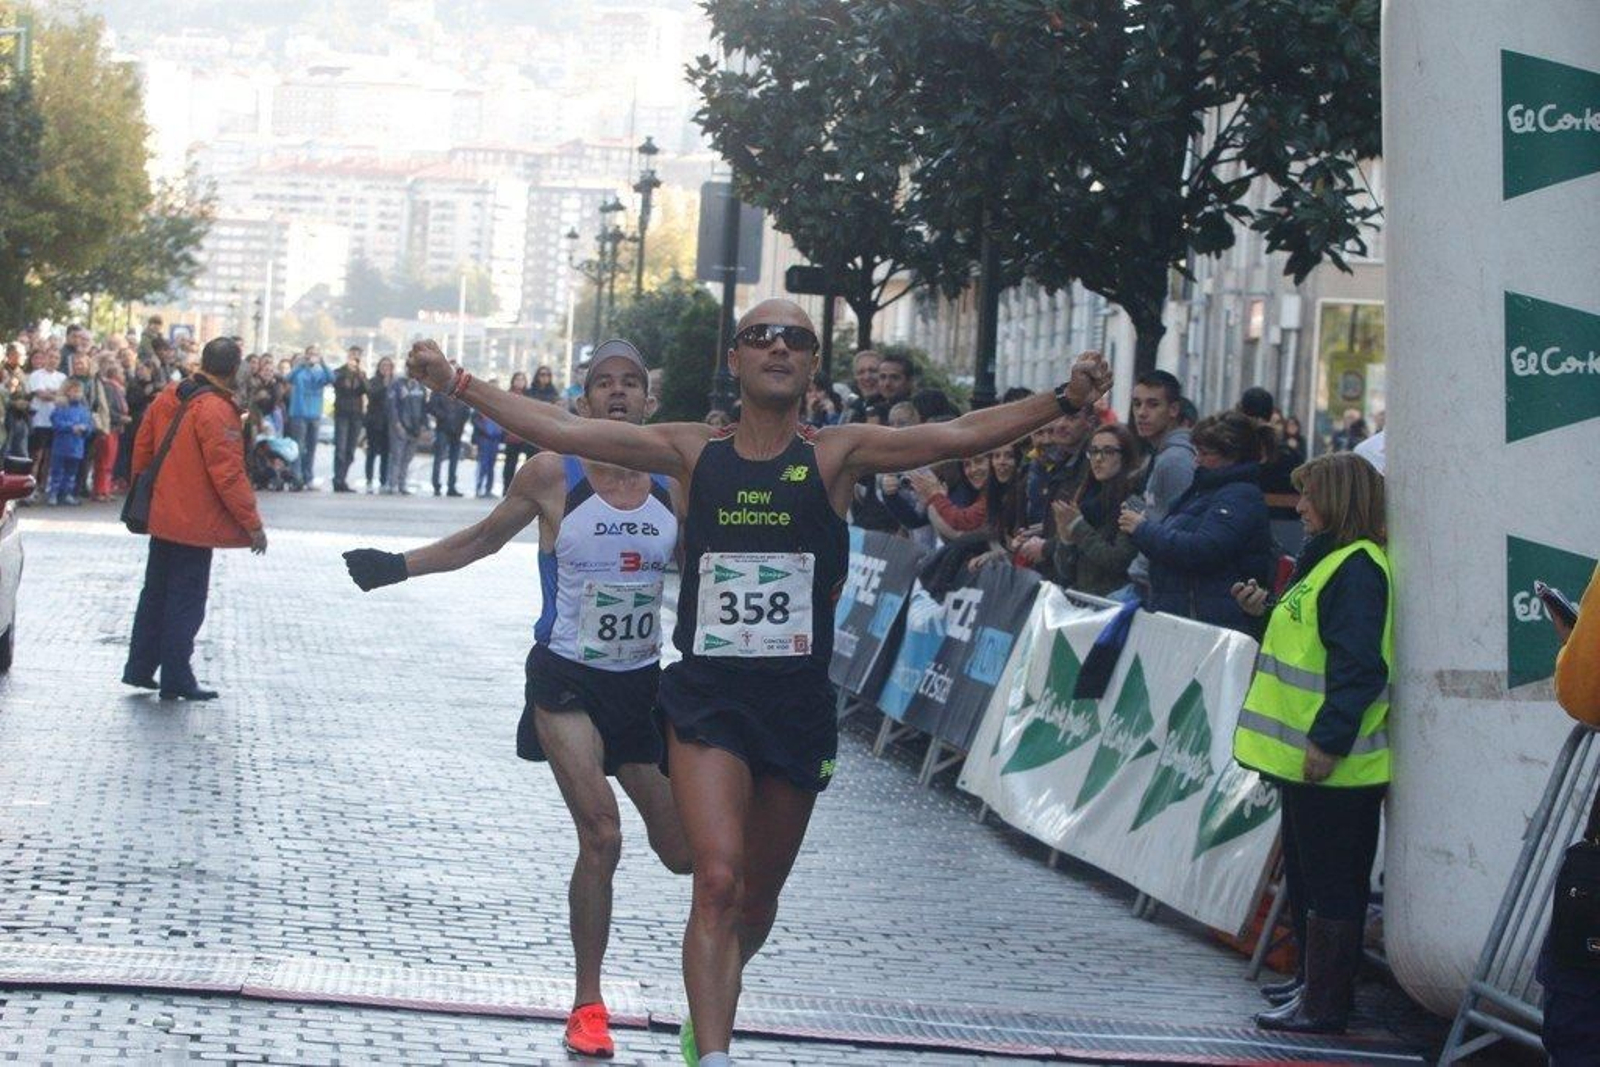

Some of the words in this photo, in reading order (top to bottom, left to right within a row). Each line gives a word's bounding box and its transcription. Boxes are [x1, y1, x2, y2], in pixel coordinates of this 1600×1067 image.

[1507, 104, 1536, 133] El
[1511, 346, 1539, 376] El
[736, 490, 773, 504] new
[718, 508, 791, 526] balance
[719, 591, 790, 625] 358
[1513, 591, 1542, 622] El
[597, 612, 654, 641] 810
